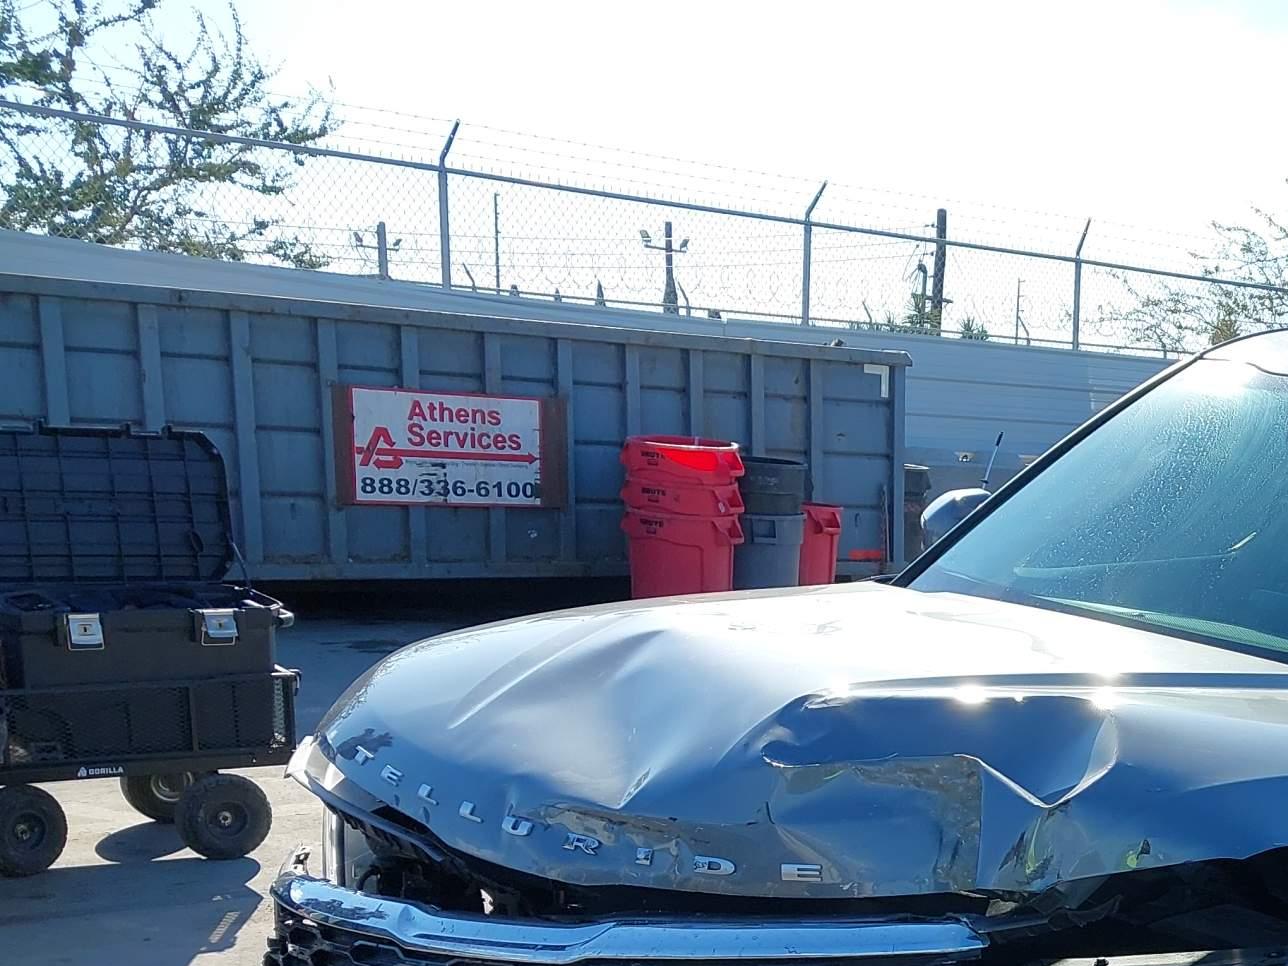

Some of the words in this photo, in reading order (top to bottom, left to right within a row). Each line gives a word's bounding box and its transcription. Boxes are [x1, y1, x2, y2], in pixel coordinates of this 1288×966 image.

[408, 400, 501, 426] Athens
[407, 423, 522, 450] Services
[360, 476, 535, 498] 888/336-6100
[88, 766, 124, 775] GORILLA
[354, 745, 823, 882] TELLURIDE
